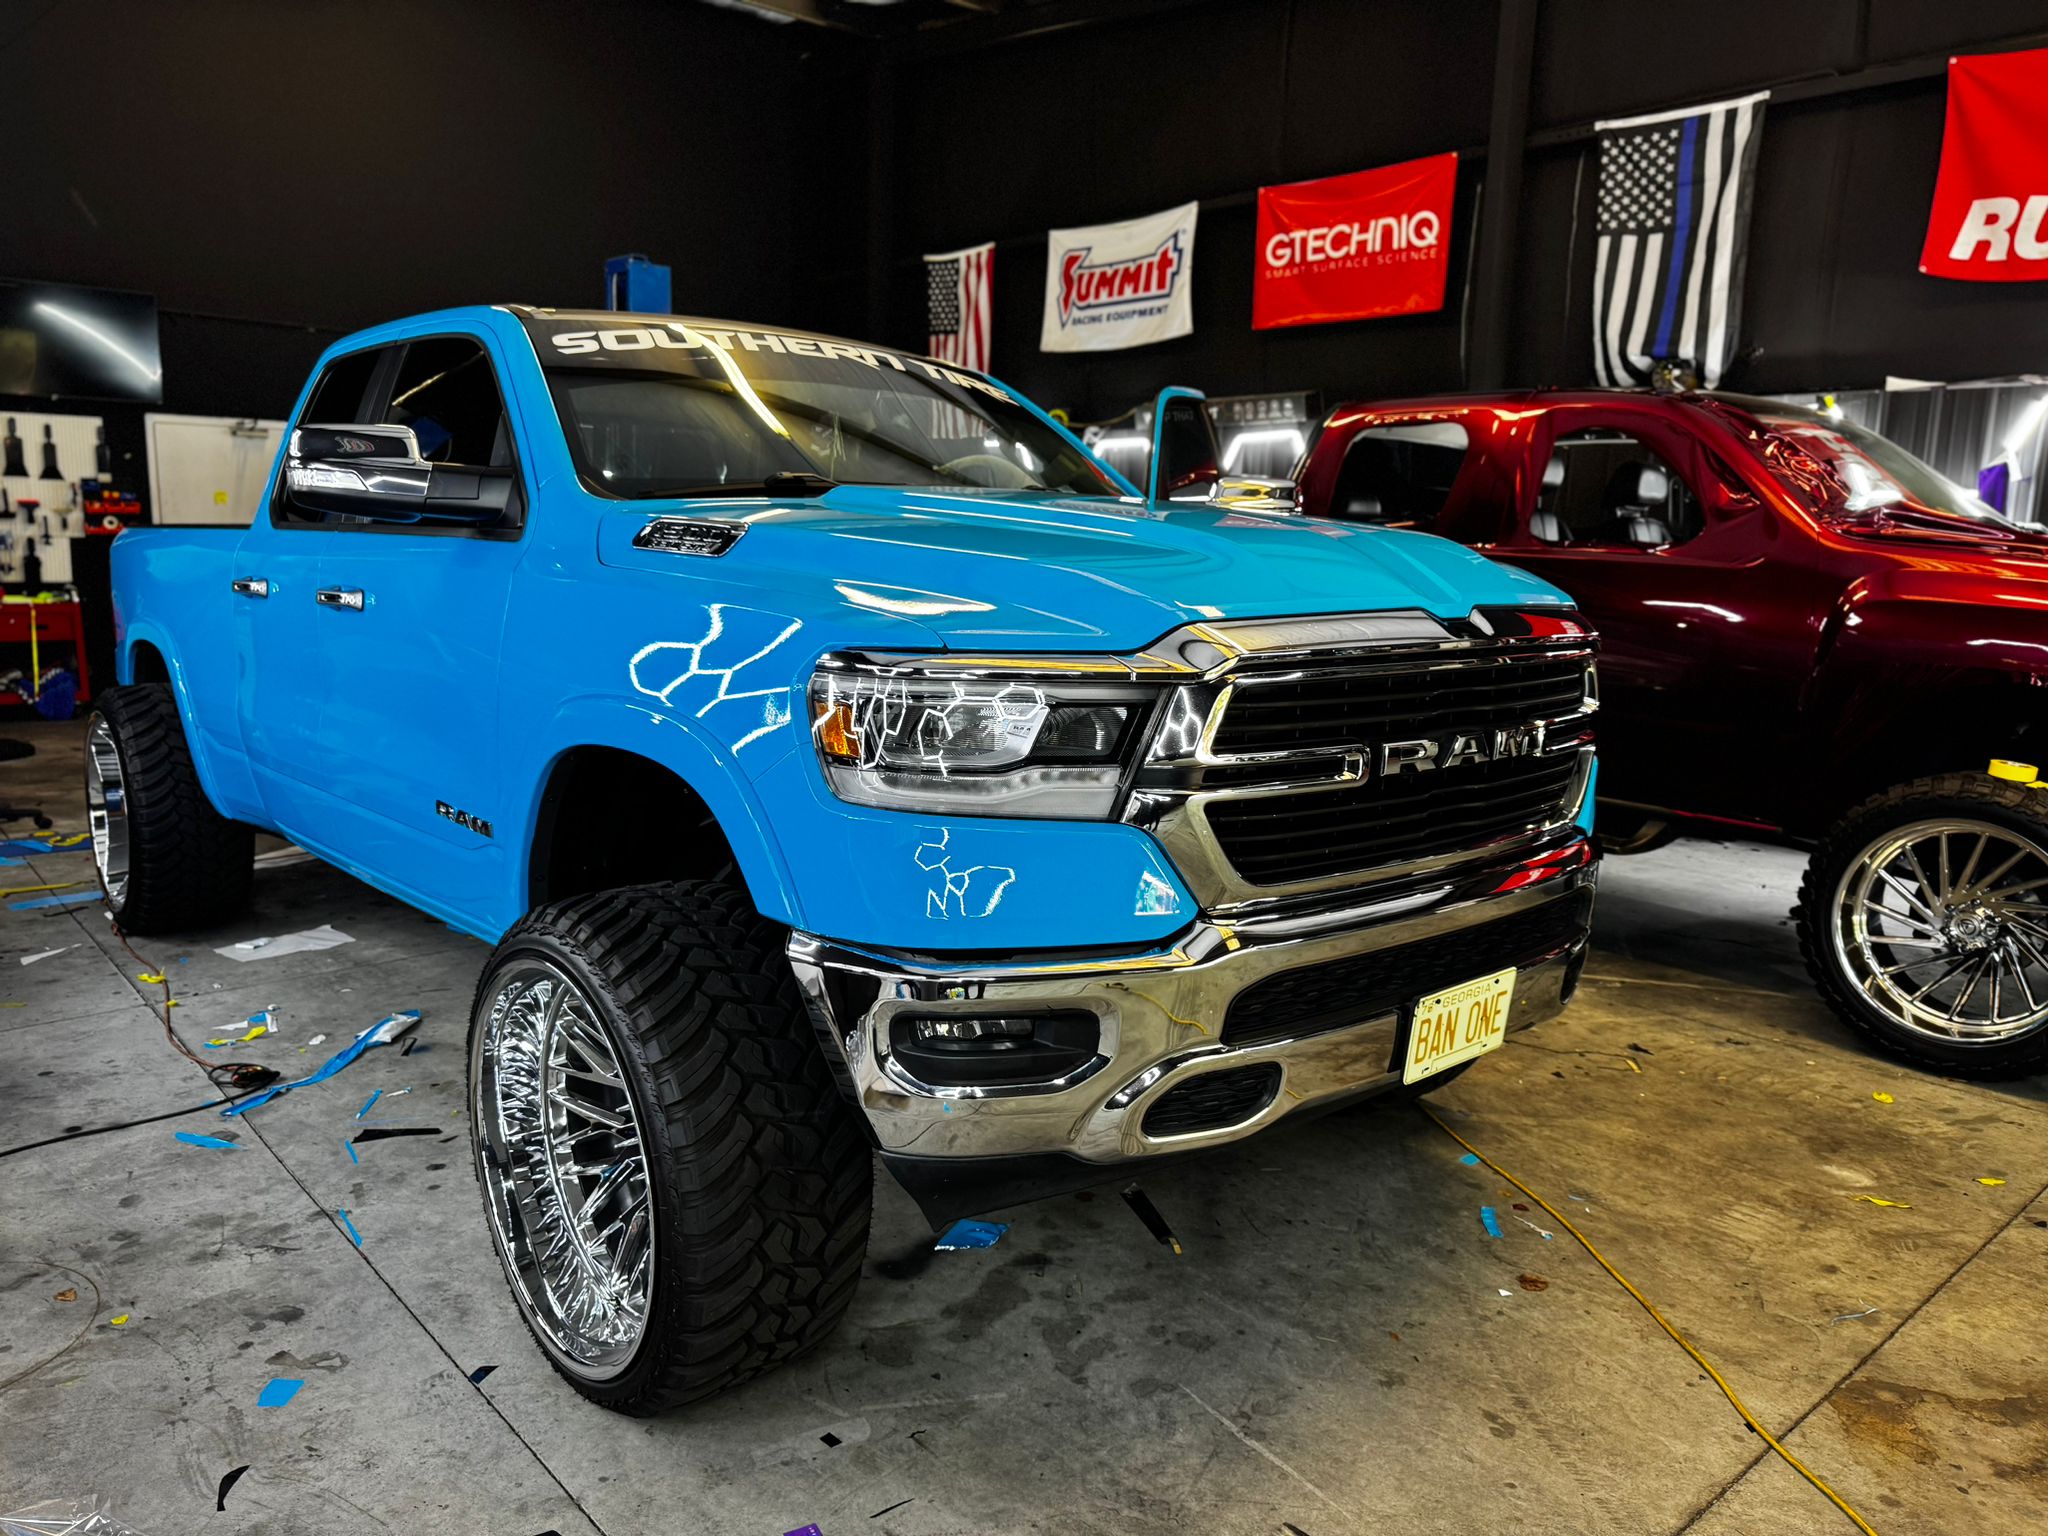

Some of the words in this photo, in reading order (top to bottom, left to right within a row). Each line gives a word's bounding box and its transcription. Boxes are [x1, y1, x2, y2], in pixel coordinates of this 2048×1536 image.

[1265, 210, 1440, 268] GTECHNIQ
[1264, 266, 1306, 280] SMART
[1312, 256, 1369, 273] SURFACE
[1376, 247, 1438, 266] SCIENCE
[1071, 314, 1103, 326] RACING
[1105, 304, 1169, 322] EQUIPMENT
[551, 328, 906, 371] SOUTHERN
[906, 358, 1020, 406] TIRE
[1380, 720, 1546, 777] RAM
[435, 799, 494, 839] RAM
[1442, 983, 1491, 1008] GEORGIA
[1413, 1007, 1460, 1065] BAN
[1465, 990, 1508, 1044] ONE
